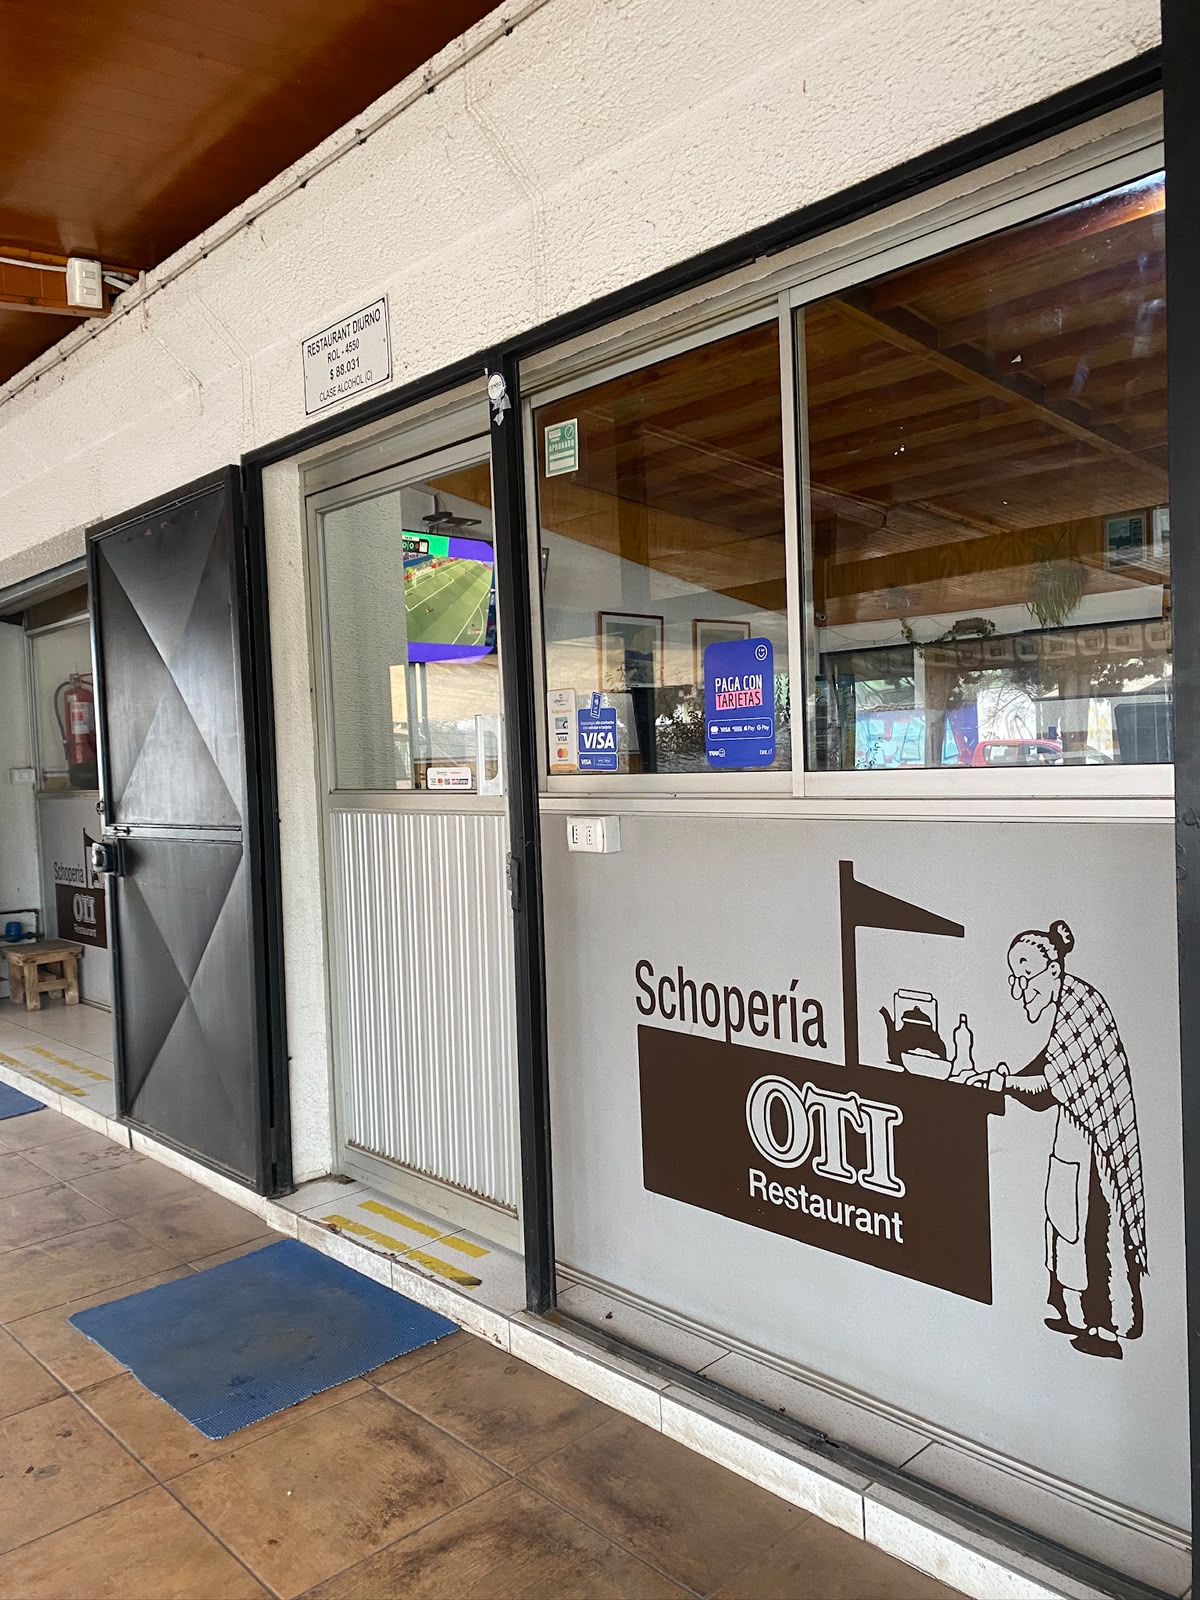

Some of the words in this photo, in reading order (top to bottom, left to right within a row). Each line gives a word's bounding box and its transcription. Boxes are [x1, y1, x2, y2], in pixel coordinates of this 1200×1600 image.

[307, 323, 351, 358] RESTAURANT
[353, 308, 381, 334] DIURNO
[327, 348, 341, 363] ROL
[345, 338, 360, 353] 4550
[329, 368, 334, 381] $
[335, 356, 360, 379] 88.031
[319, 386, 337, 402] CLASE
[337, 373, 364, 393] ALCOHOL
[365, 369, 373, 384] (C)
[549, 438, 575, 453] APROBADO
[715, 676, 741, 692] PAGA
[743, 674, 763, 690] CON
[717, 691, 761, 709] TARJETAS
[580, 731, 615, 749] VISA
[73, 893, 96, 924] OTI
[635, 959, 828, 1049] Schopería
[746, 1075, 906, 1198] OTI
[749, 1168, 904, 1243] Restaurant
